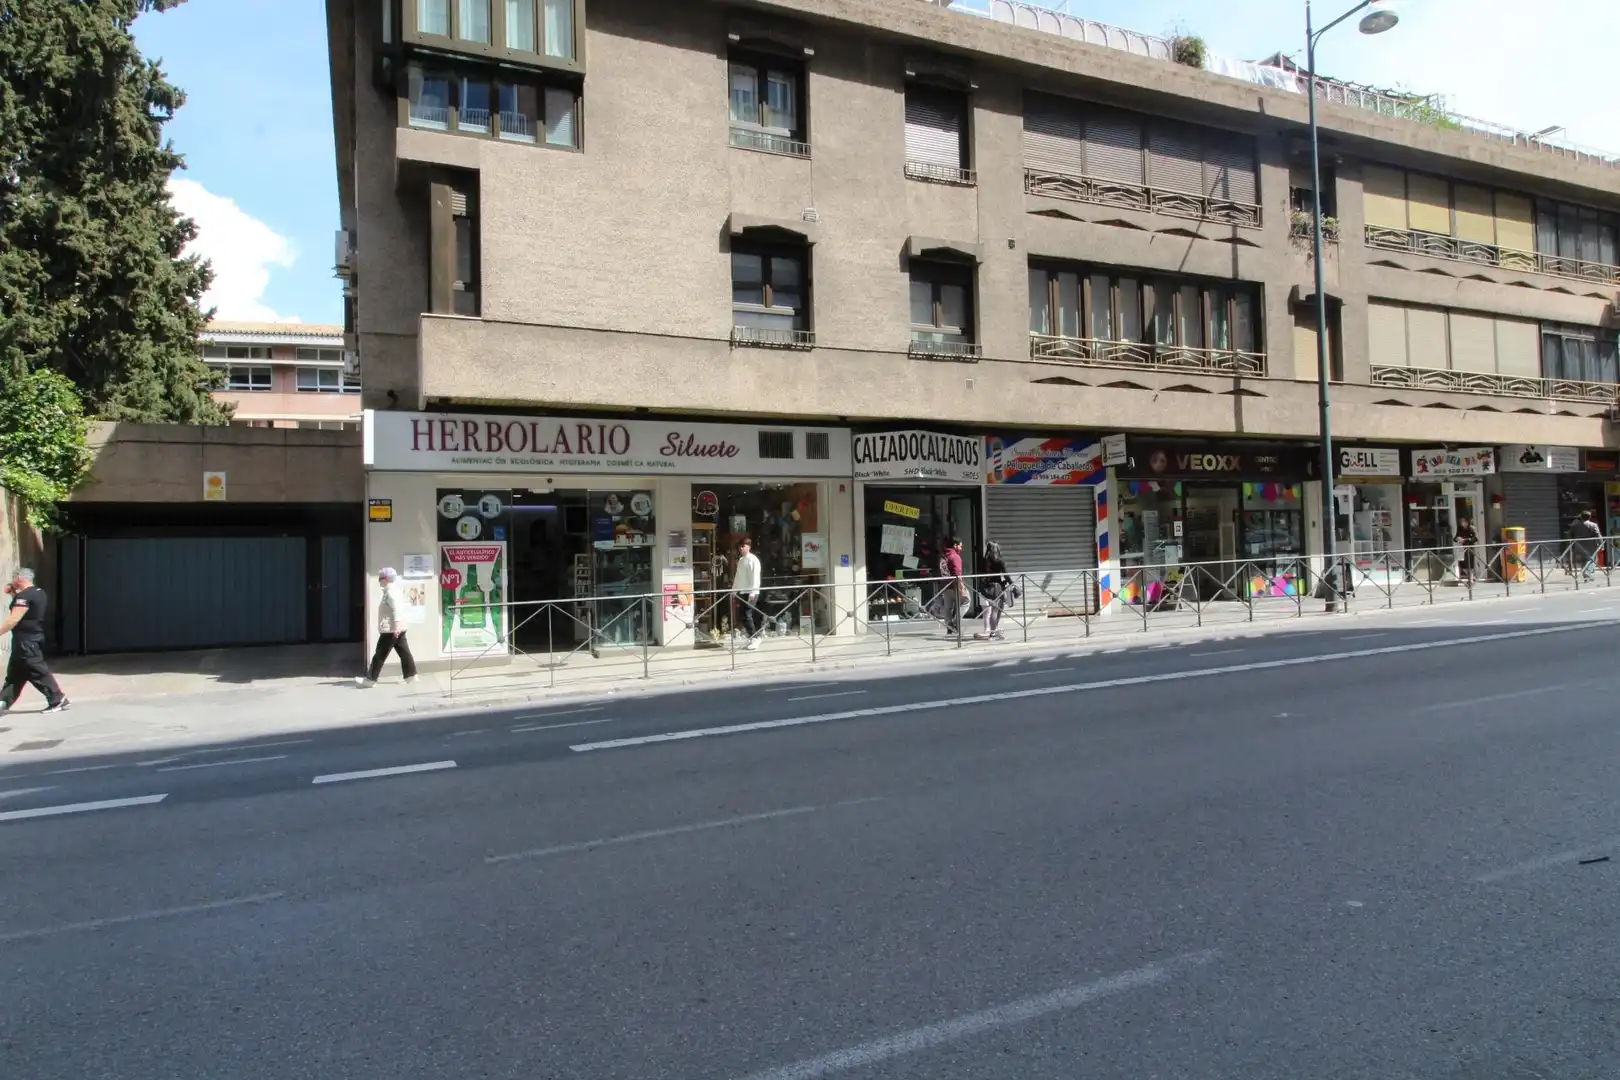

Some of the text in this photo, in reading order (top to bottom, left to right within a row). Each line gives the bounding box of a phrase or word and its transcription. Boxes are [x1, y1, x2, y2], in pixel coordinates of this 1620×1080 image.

[410, 419, 740, 458] HERBOLARIO Siluete
[920, 433, 979, 466] CALZADOS
[451, 457, 506, 465] ALIMENTACÓN
[606, 459, 643, 467] COSMÉTCA
[1176, 454, 1241, 471] VEOXX
